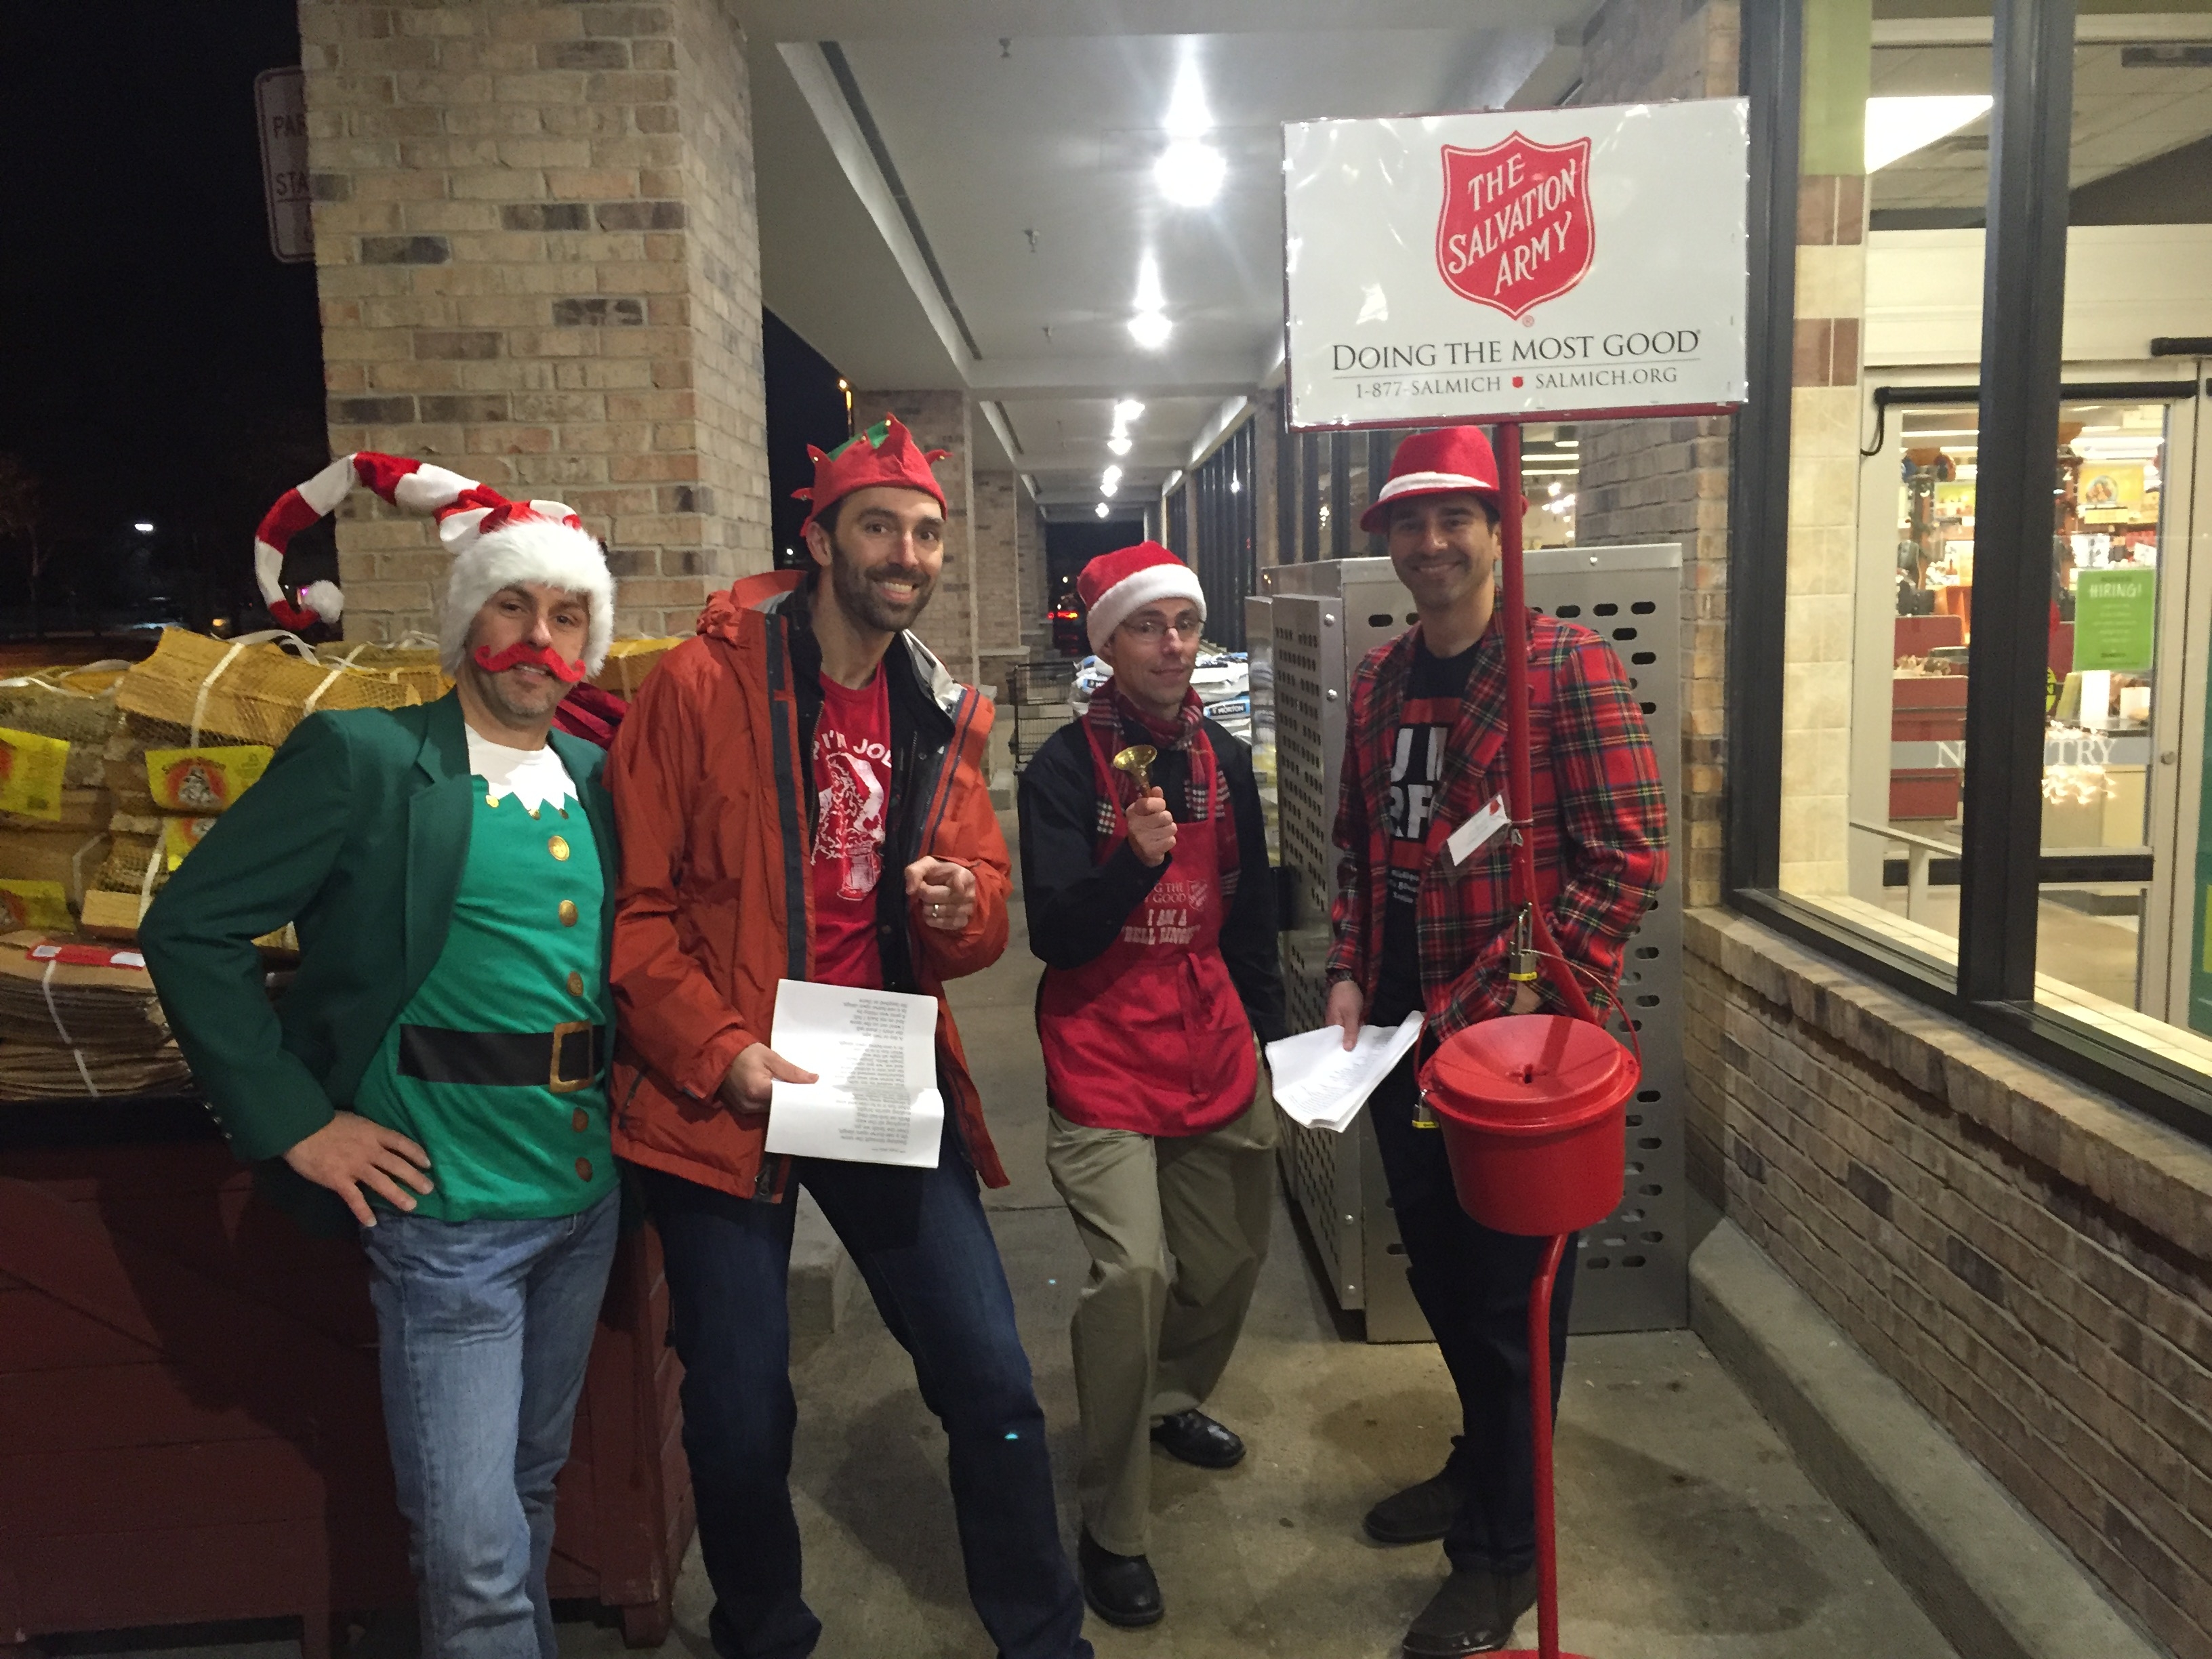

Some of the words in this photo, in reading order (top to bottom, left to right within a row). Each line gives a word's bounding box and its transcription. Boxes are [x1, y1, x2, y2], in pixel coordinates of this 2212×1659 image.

[1467, 152, 1526, 212] THE
[1448, 158, 1576, 274] SALVATION
[1493, 210, 1572, 296] ARMY
[1333, 344, 1436, 371] DOING
[1444, 340, 1502, 365] THE
[1511, 335, 1595, 362] MOST
[1603, 329, 1699, 357] GOOD
[1355, 376, 1501, 399] 1-877-SALMICH
[1535, 367, 1677, 389] SALMICH.ORG
[2089, 582, 2142, 598] HIRING!
[1936, 739, 1966, 769] N
[2044, 737, 2116, 764] TRY
[1153, 893, 1187, 904] GOOD
